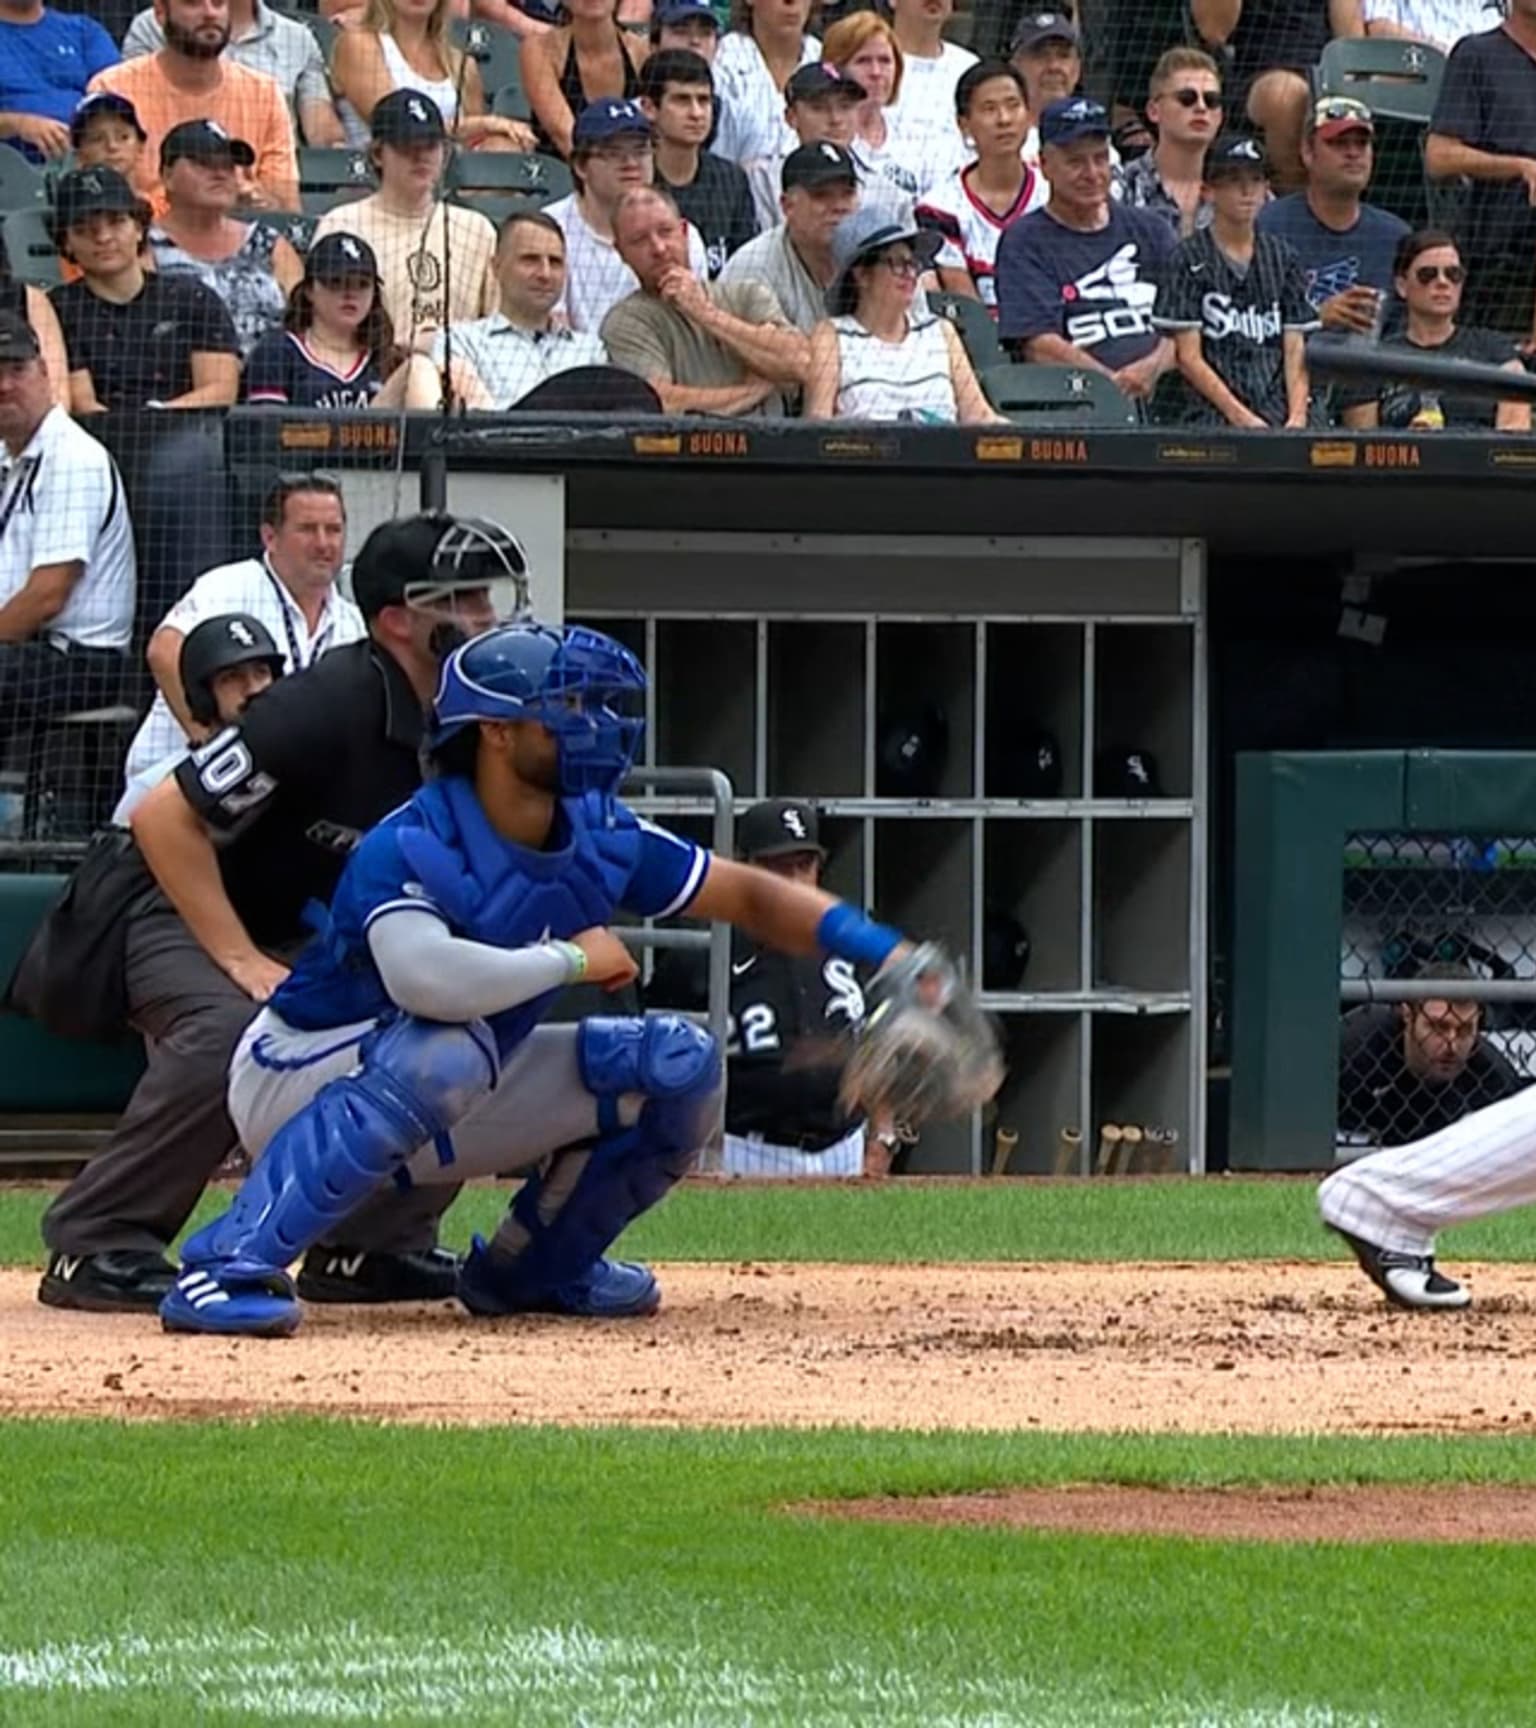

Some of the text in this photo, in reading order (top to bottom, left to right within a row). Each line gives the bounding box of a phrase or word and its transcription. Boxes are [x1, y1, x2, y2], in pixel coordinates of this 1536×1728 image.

[338, 426, 397, 447] BUONA
[690, 433, 747, 455] BUONA
[1031, 439, 1087, 461] BUONA
[1365, 444, 1420, 466] BUONA
